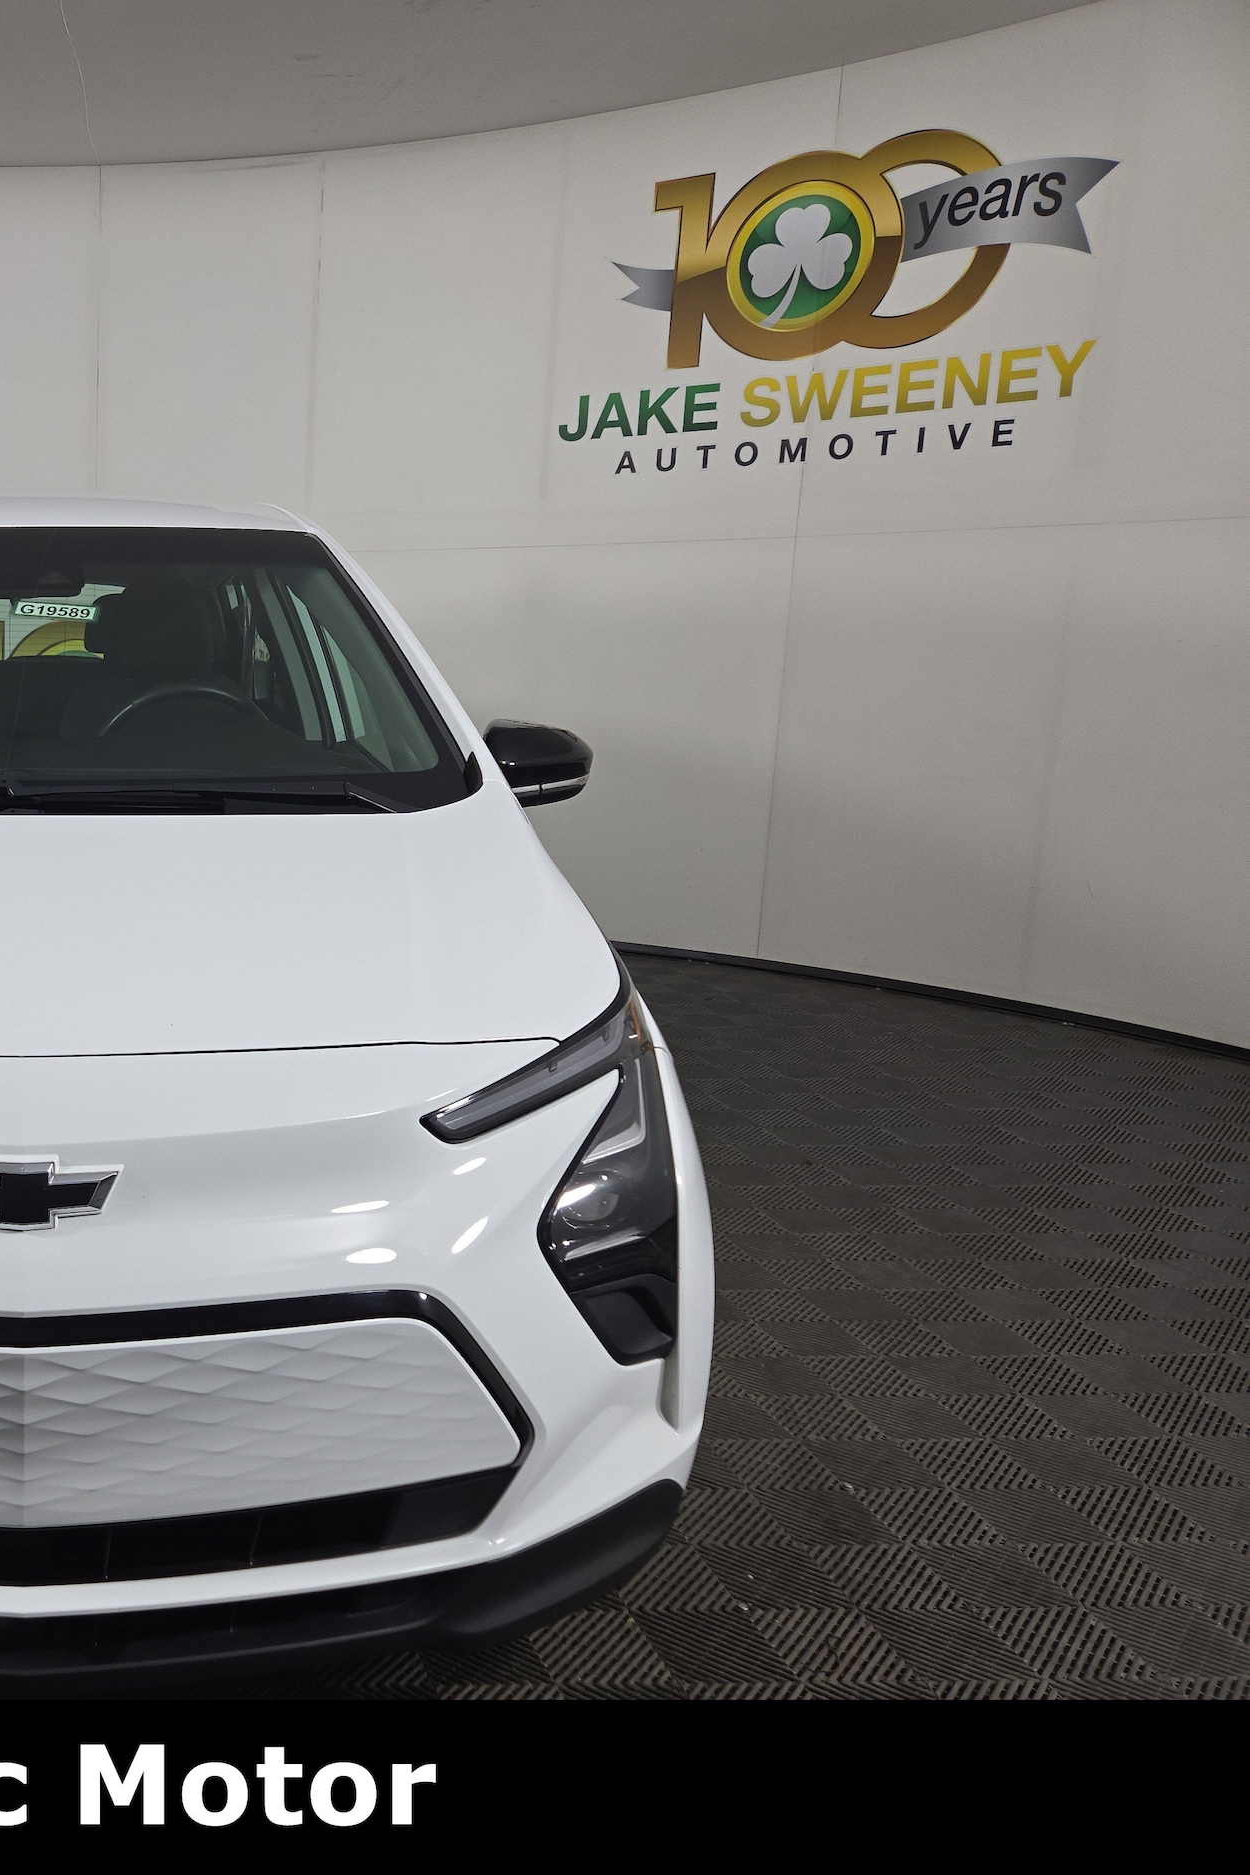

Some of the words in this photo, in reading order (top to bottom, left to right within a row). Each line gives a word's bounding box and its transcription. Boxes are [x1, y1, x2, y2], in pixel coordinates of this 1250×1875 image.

[913, 170, 1067, 250] years
[558, 382, 721, 442] JAKE
[739, 339, 1097, 428] SWEENEY
[615, 418, 1015, 475] AUTOMOTIVE
[20, 603, 91, 619] G19589
